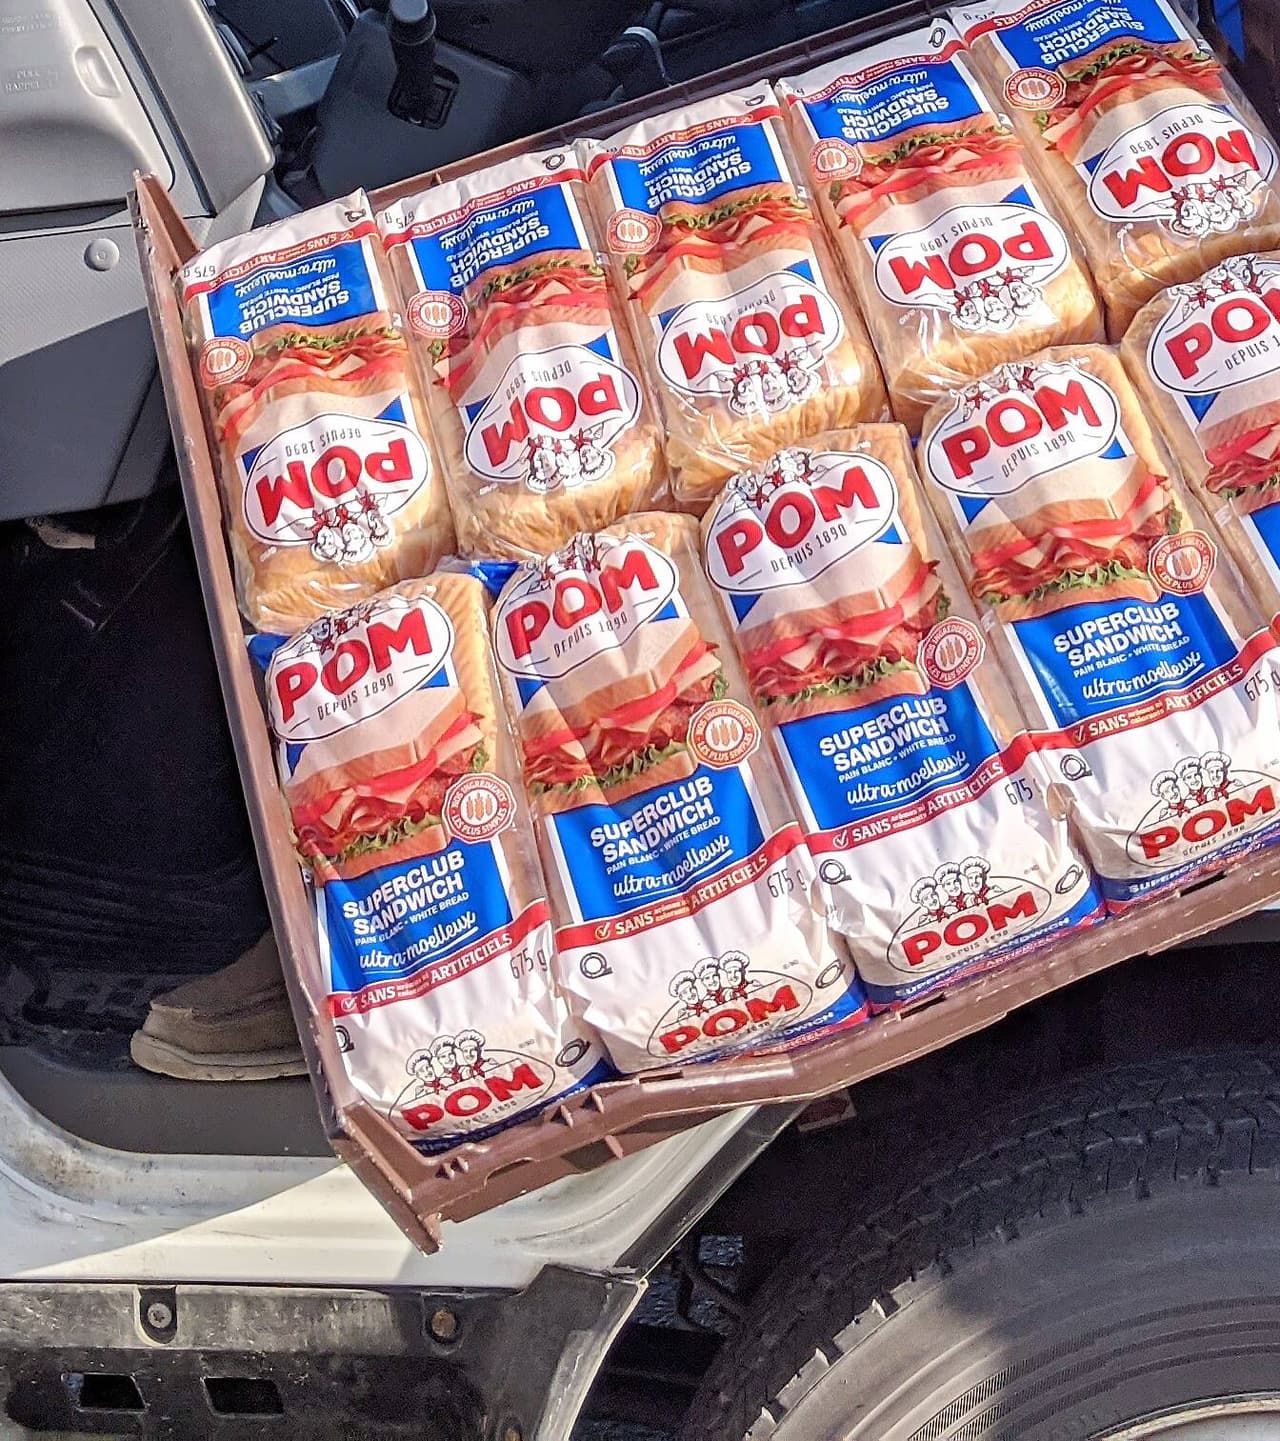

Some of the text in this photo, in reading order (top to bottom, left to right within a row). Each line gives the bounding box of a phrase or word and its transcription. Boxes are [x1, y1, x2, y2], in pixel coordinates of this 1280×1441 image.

[1040, 11, 1133, 53] SANDWICH
[1043, 20, 1144, 65] SUPERCLUB
[841, 89, 938, 127] SANDWICH
[841, 97, 949, 140] SUPERCLUB
[1129, 114, 1204, 155] DEPUIS 1890
[505, 180, 536, 198] SANS
[647, 161, 751, 209] SUPERCLUB
[648, 153, 741, 195] SANDWICH
[1103, 129, 1260, 209] POM
[307, 232, 337, 250] SANS
[451, 217, 541, 274] SANDWICH
[952, 217, 994, 237] DEPUIS
[194, 265, 216, 277] 675
[234, 258, 336, 296] ultra-moelleux
[449, 225, 550, 288] SUPERCLUB
[888, 221, 1054, 294] POM
[239, 291, 349, 334] SUPERCLUB
[243, 281, 341, 318] SANDWICH
[673, 294, 825, 380] POM
[1225, 338, 1270, 370] DEPUIS
[285, 427, 361, 458] DEPUIS 1890
[480, 373, 622, 467] POM
[942, 380, 1101, 479] POM
[1001, 430, 1076, 478] DEPUIS 1890
[255, 438, 413, 527] POM
[716, 466, 880, 577] POM
[770, 523, 847, 573] DEPUIS 1890
[505, 550, 660, 660] POM
[1054, 603, 1179, 653] SUPERCLUB
[553, 611, 628, 658] DEPUIS 1890
[1067, 622, 1182, 667] SANDWICH
[1074, 636, 1190, 678] PAIN BLANC WHITE BREAD
[276, 608, 432, 723] POM
[1082, 651, 1204, 704] ultra-moelleux
[1244, 671, 1270, 702] 675
[317, 676, 395, 721] DEPUIS 1890
[1089, 664, 1244, 736] SANS ARTIFICIELS
[820, 697, 947, 757] SUPERCLUB
[834, 717, 950, 772] SANDWICH
[839, 768, 860, 783] PAIN
[861, 758, 893, 774] BLANC
[898, 741, 926, 759] WHITE
[847, 750, 969, 810] ultra-moelleux
[590, 776, 714, 847] SUPERCLUB
[852, 761, 1004, 842] SANS ARTIFICIELS
[1005, 779, 1033, 806] 675
[603, 797, 714, 862] SANDWICH
[606, 861, 626, 875] PAIN
[628, 850, 659, 865] BLANC
[691, 815, 720, 834] BREAD
[1140, 785, 1275, 859] POM
[342, 850, 465, 919] SUPERCLUB
[613, 834, 733, 902] ultra-moelleux
[615, 911, 654, 935] SANS
[691, 854, 769, 909] ARTIFICIELS
[767, 868, 794, 898] 675
[353, 872, 463, 937] SANDWICH
[355, 935, 376, 947] PAIN
[410, 906, 438, 924] WHITE
[439, 892, 469, 911] BREAD
[901, 891, 1038, 966] POM
[359, 911, 477, 970] ultra-moelleux
[510, 948, 534, 979] 675
[361, 933, 513, 1009] SANS ARTIFICIELS
[659, 985, 801, 1054] POM
[400, 1062, 544, 1131] POM
